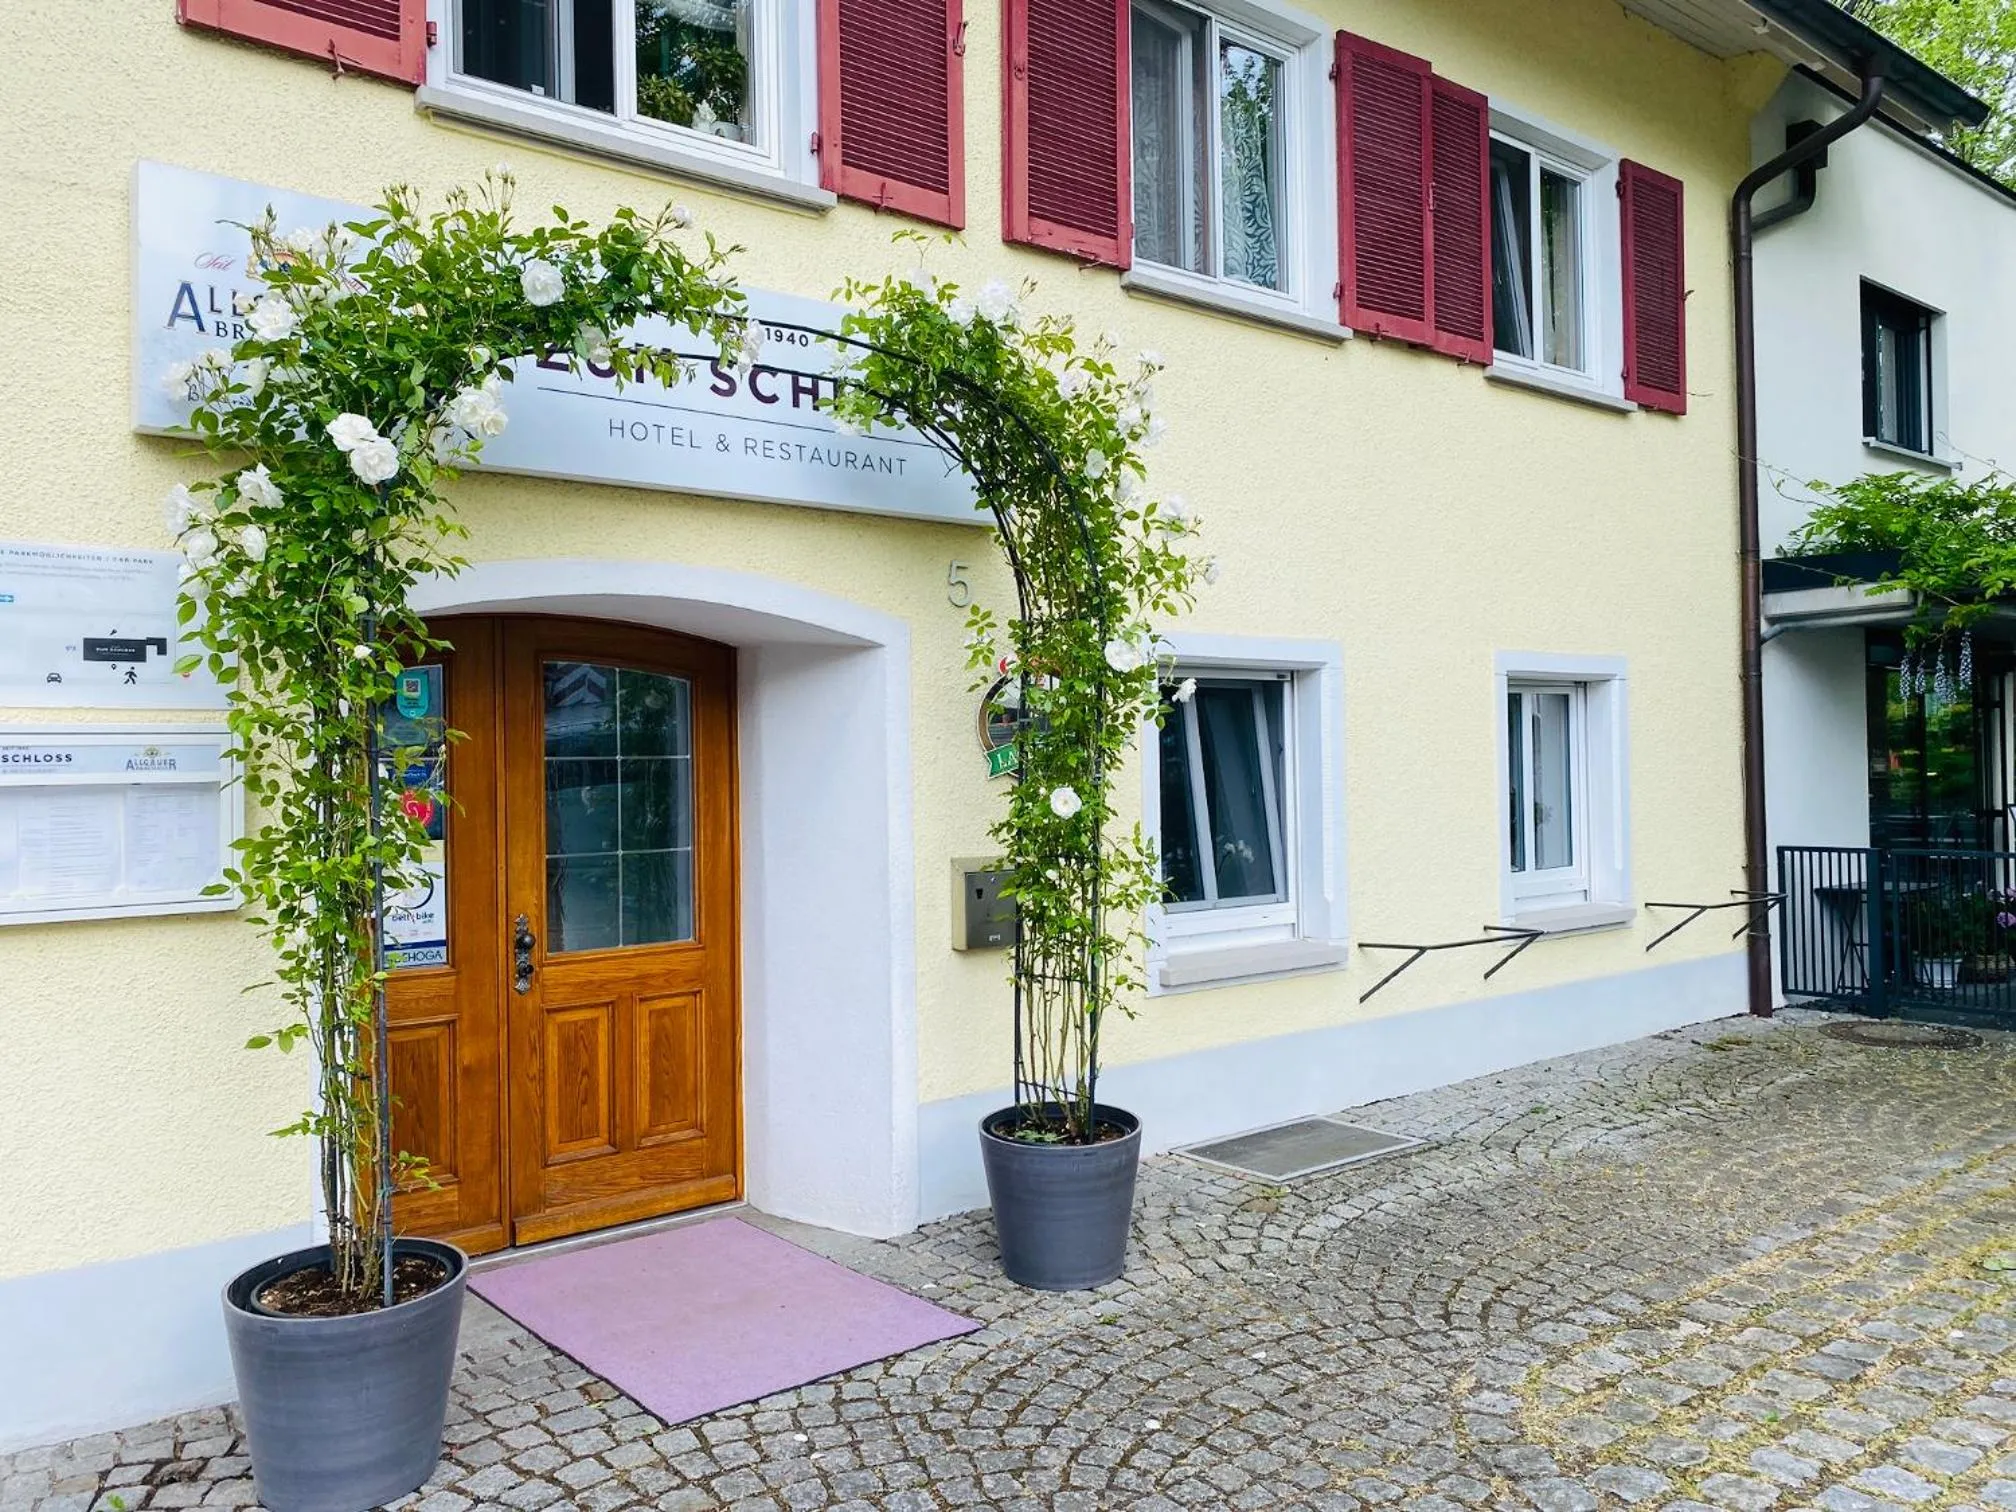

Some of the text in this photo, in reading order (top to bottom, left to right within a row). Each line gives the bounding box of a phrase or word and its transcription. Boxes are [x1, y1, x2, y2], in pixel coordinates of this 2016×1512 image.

[215, 321, 246, 340] BR
[765, 328, 809, 348] 1940
[609, 419, 907, 476] HOTEL & RESTAURANT
[949, 560, 971, 607] 5
[1, 754, 72, 763] SCHLOSS
